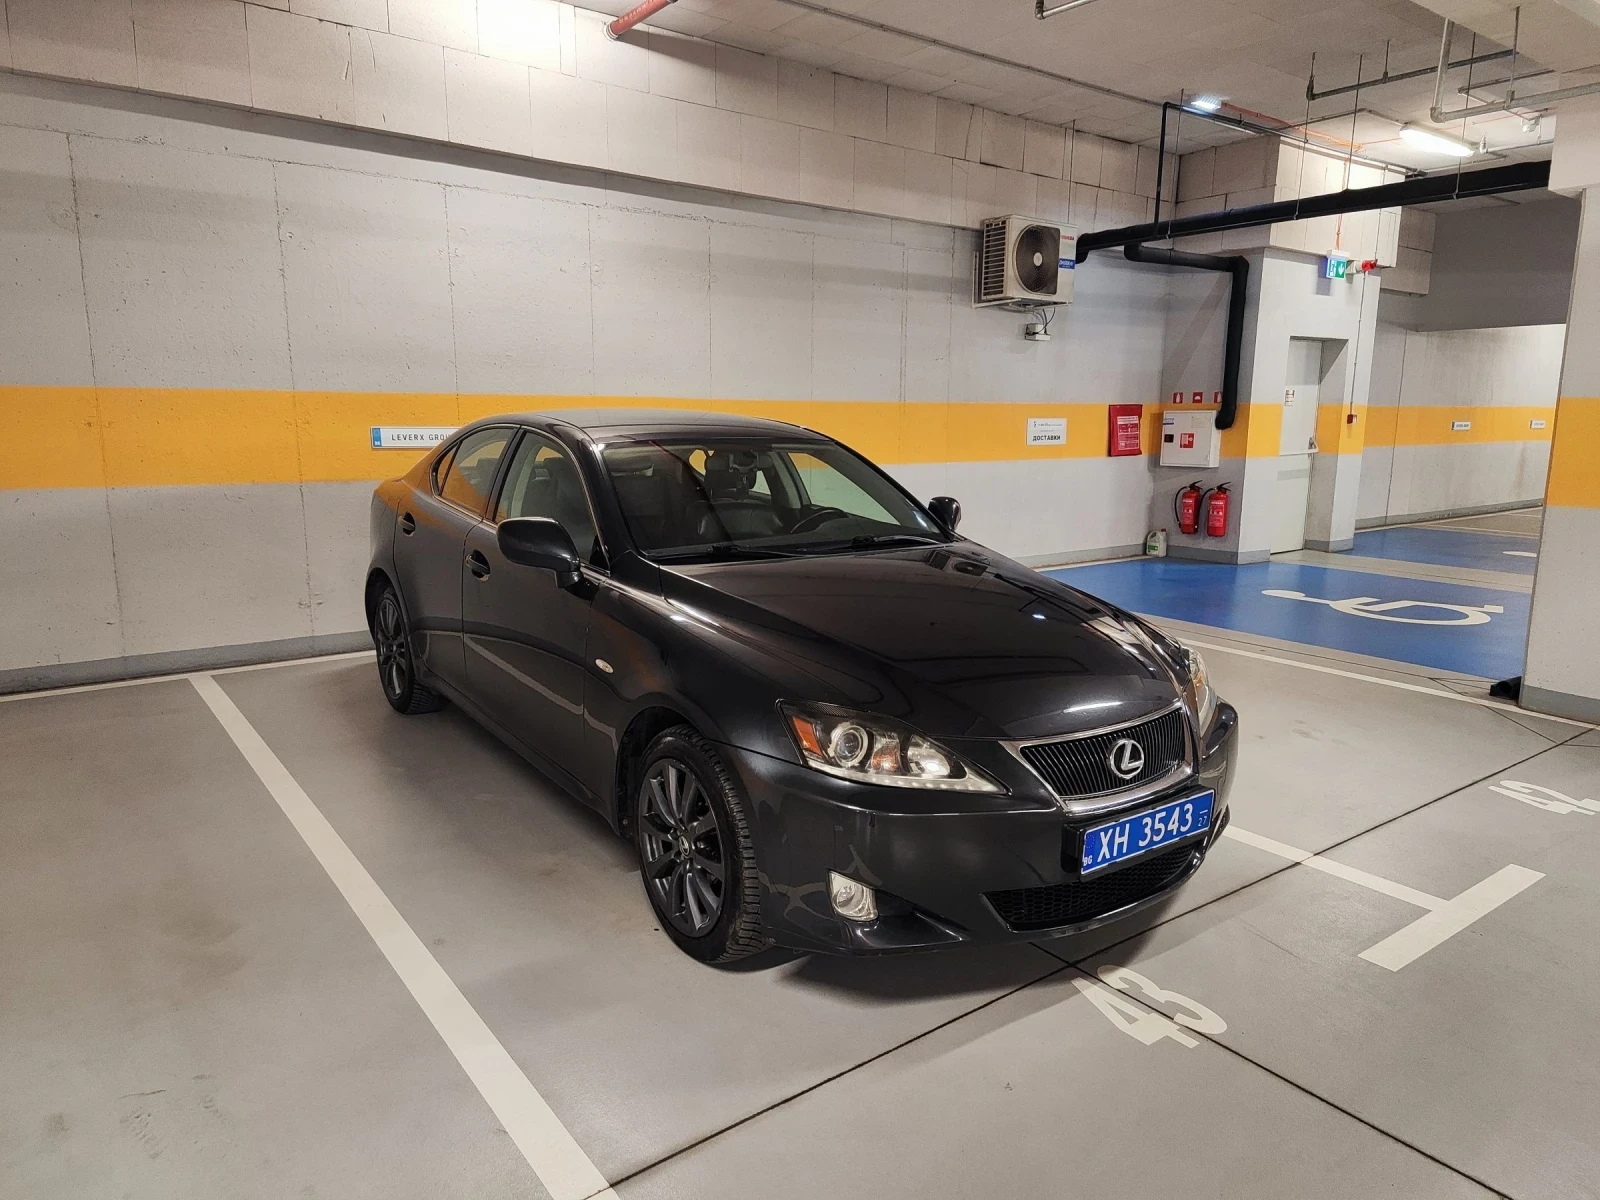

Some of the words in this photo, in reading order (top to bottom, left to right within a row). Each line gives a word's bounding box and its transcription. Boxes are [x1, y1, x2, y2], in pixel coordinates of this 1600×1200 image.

[391, 433, 425, 441] LEVERX
[1083, 855, 1093, 867] BG
[1097, 823, 1130, 863] XH
[1138, 803, 1193, 847] 3543
[1070, 964, 1228, 1049] 43
